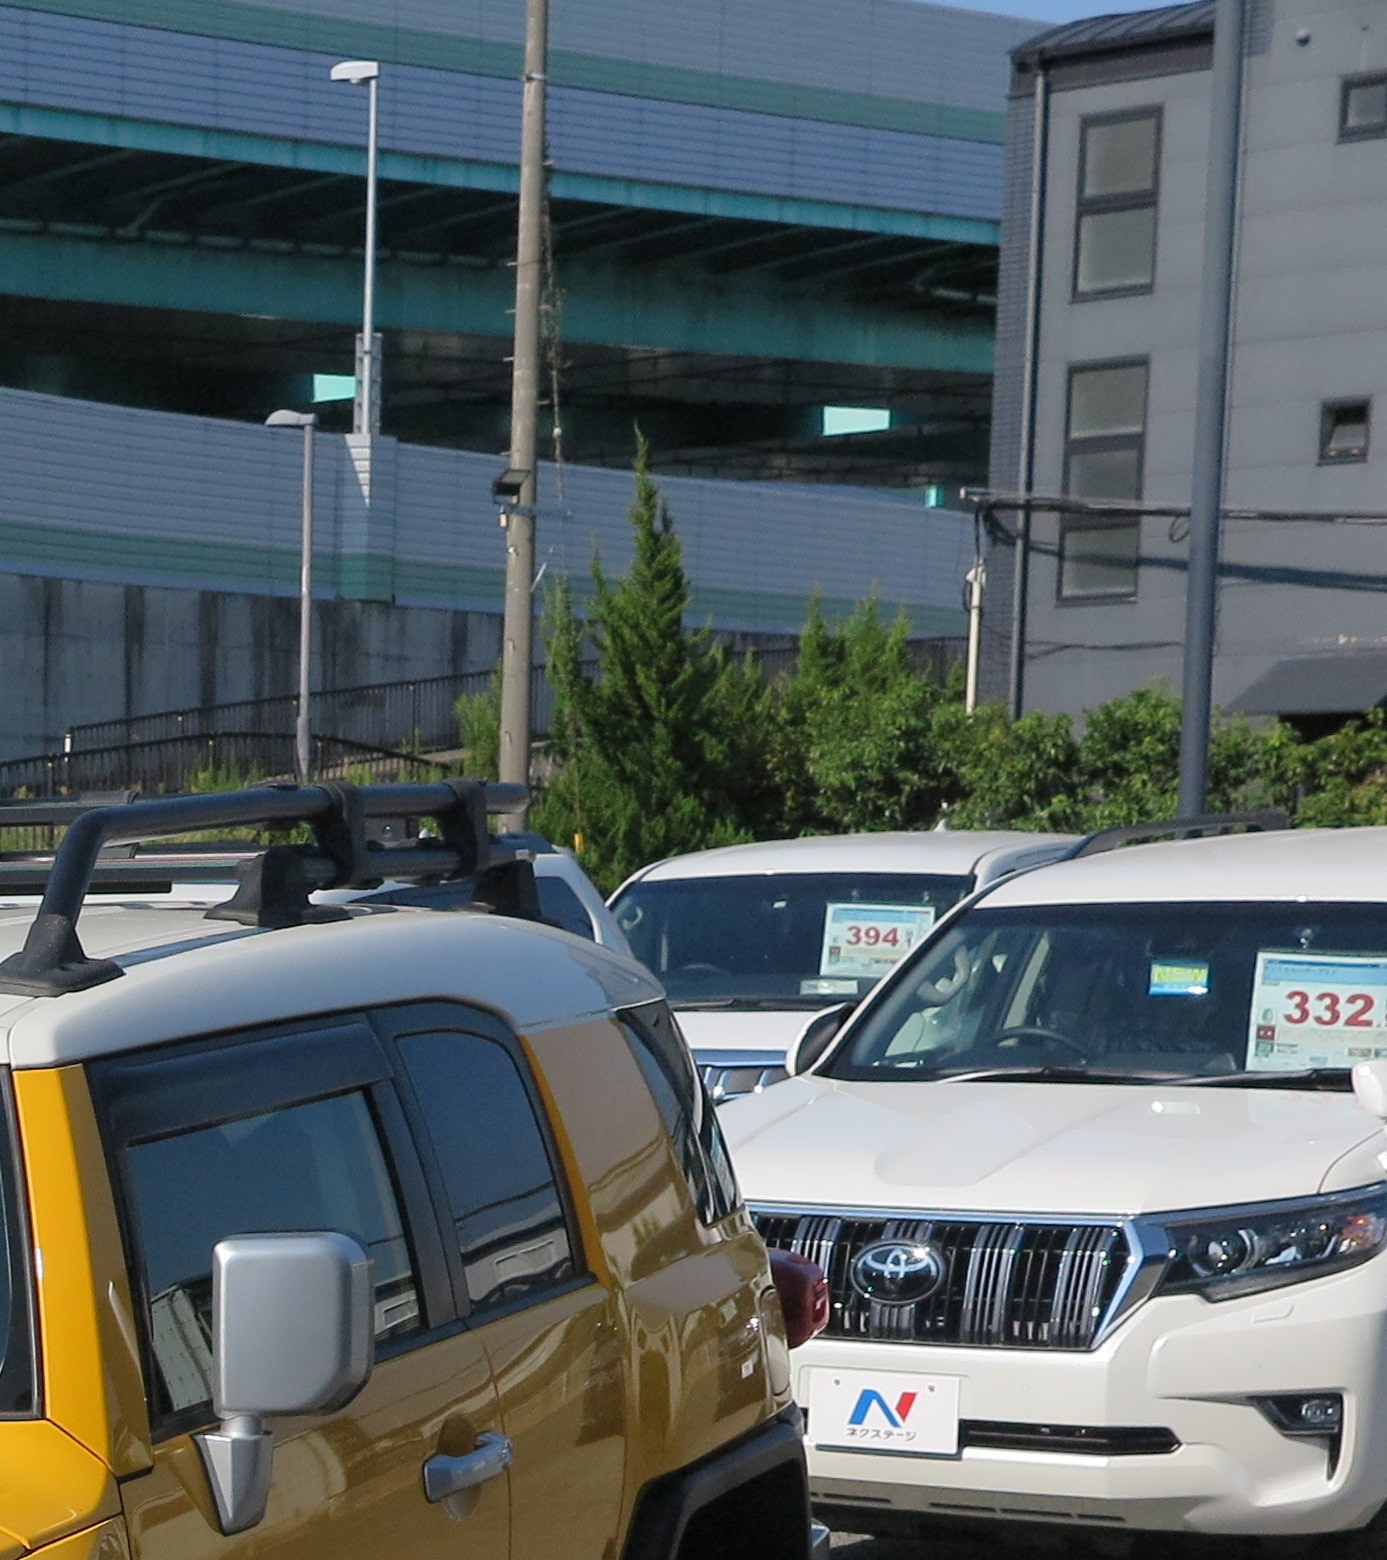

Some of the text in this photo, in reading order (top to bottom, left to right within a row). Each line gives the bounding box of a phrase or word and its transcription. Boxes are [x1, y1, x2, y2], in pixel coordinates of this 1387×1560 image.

[845, 1427, 918, 1442] ネクステージ
